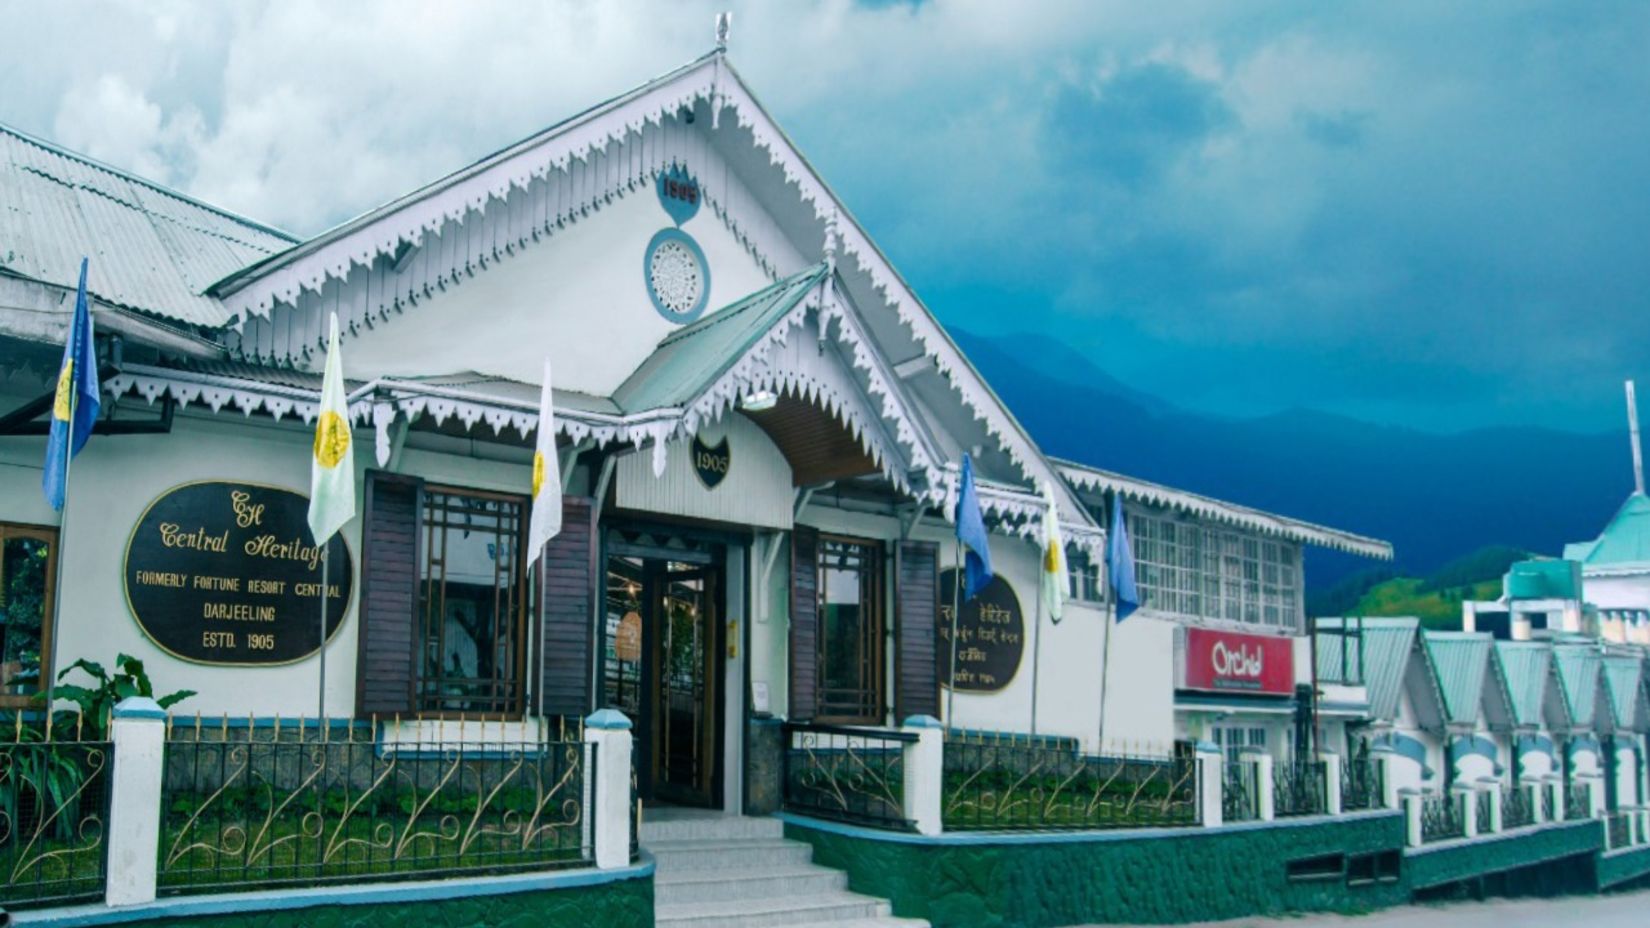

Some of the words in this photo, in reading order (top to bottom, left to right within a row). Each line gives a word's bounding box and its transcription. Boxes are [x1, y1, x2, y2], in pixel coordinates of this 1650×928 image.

[697, 451, 729, 473] 1905
[160, 522, 229, 553] Central
[136, 570, 187, 588] FORMERLY
[193, 575, 240, 593] FORTUNE
[247, 580, 286, 595] RESORT
[204, 602, 275, 622] DARJEELING
[202, 631, 236, 648] ESTD.
[247, 634, 274, 650] 1905
[1212, 640, 1263, 677] Orchid
